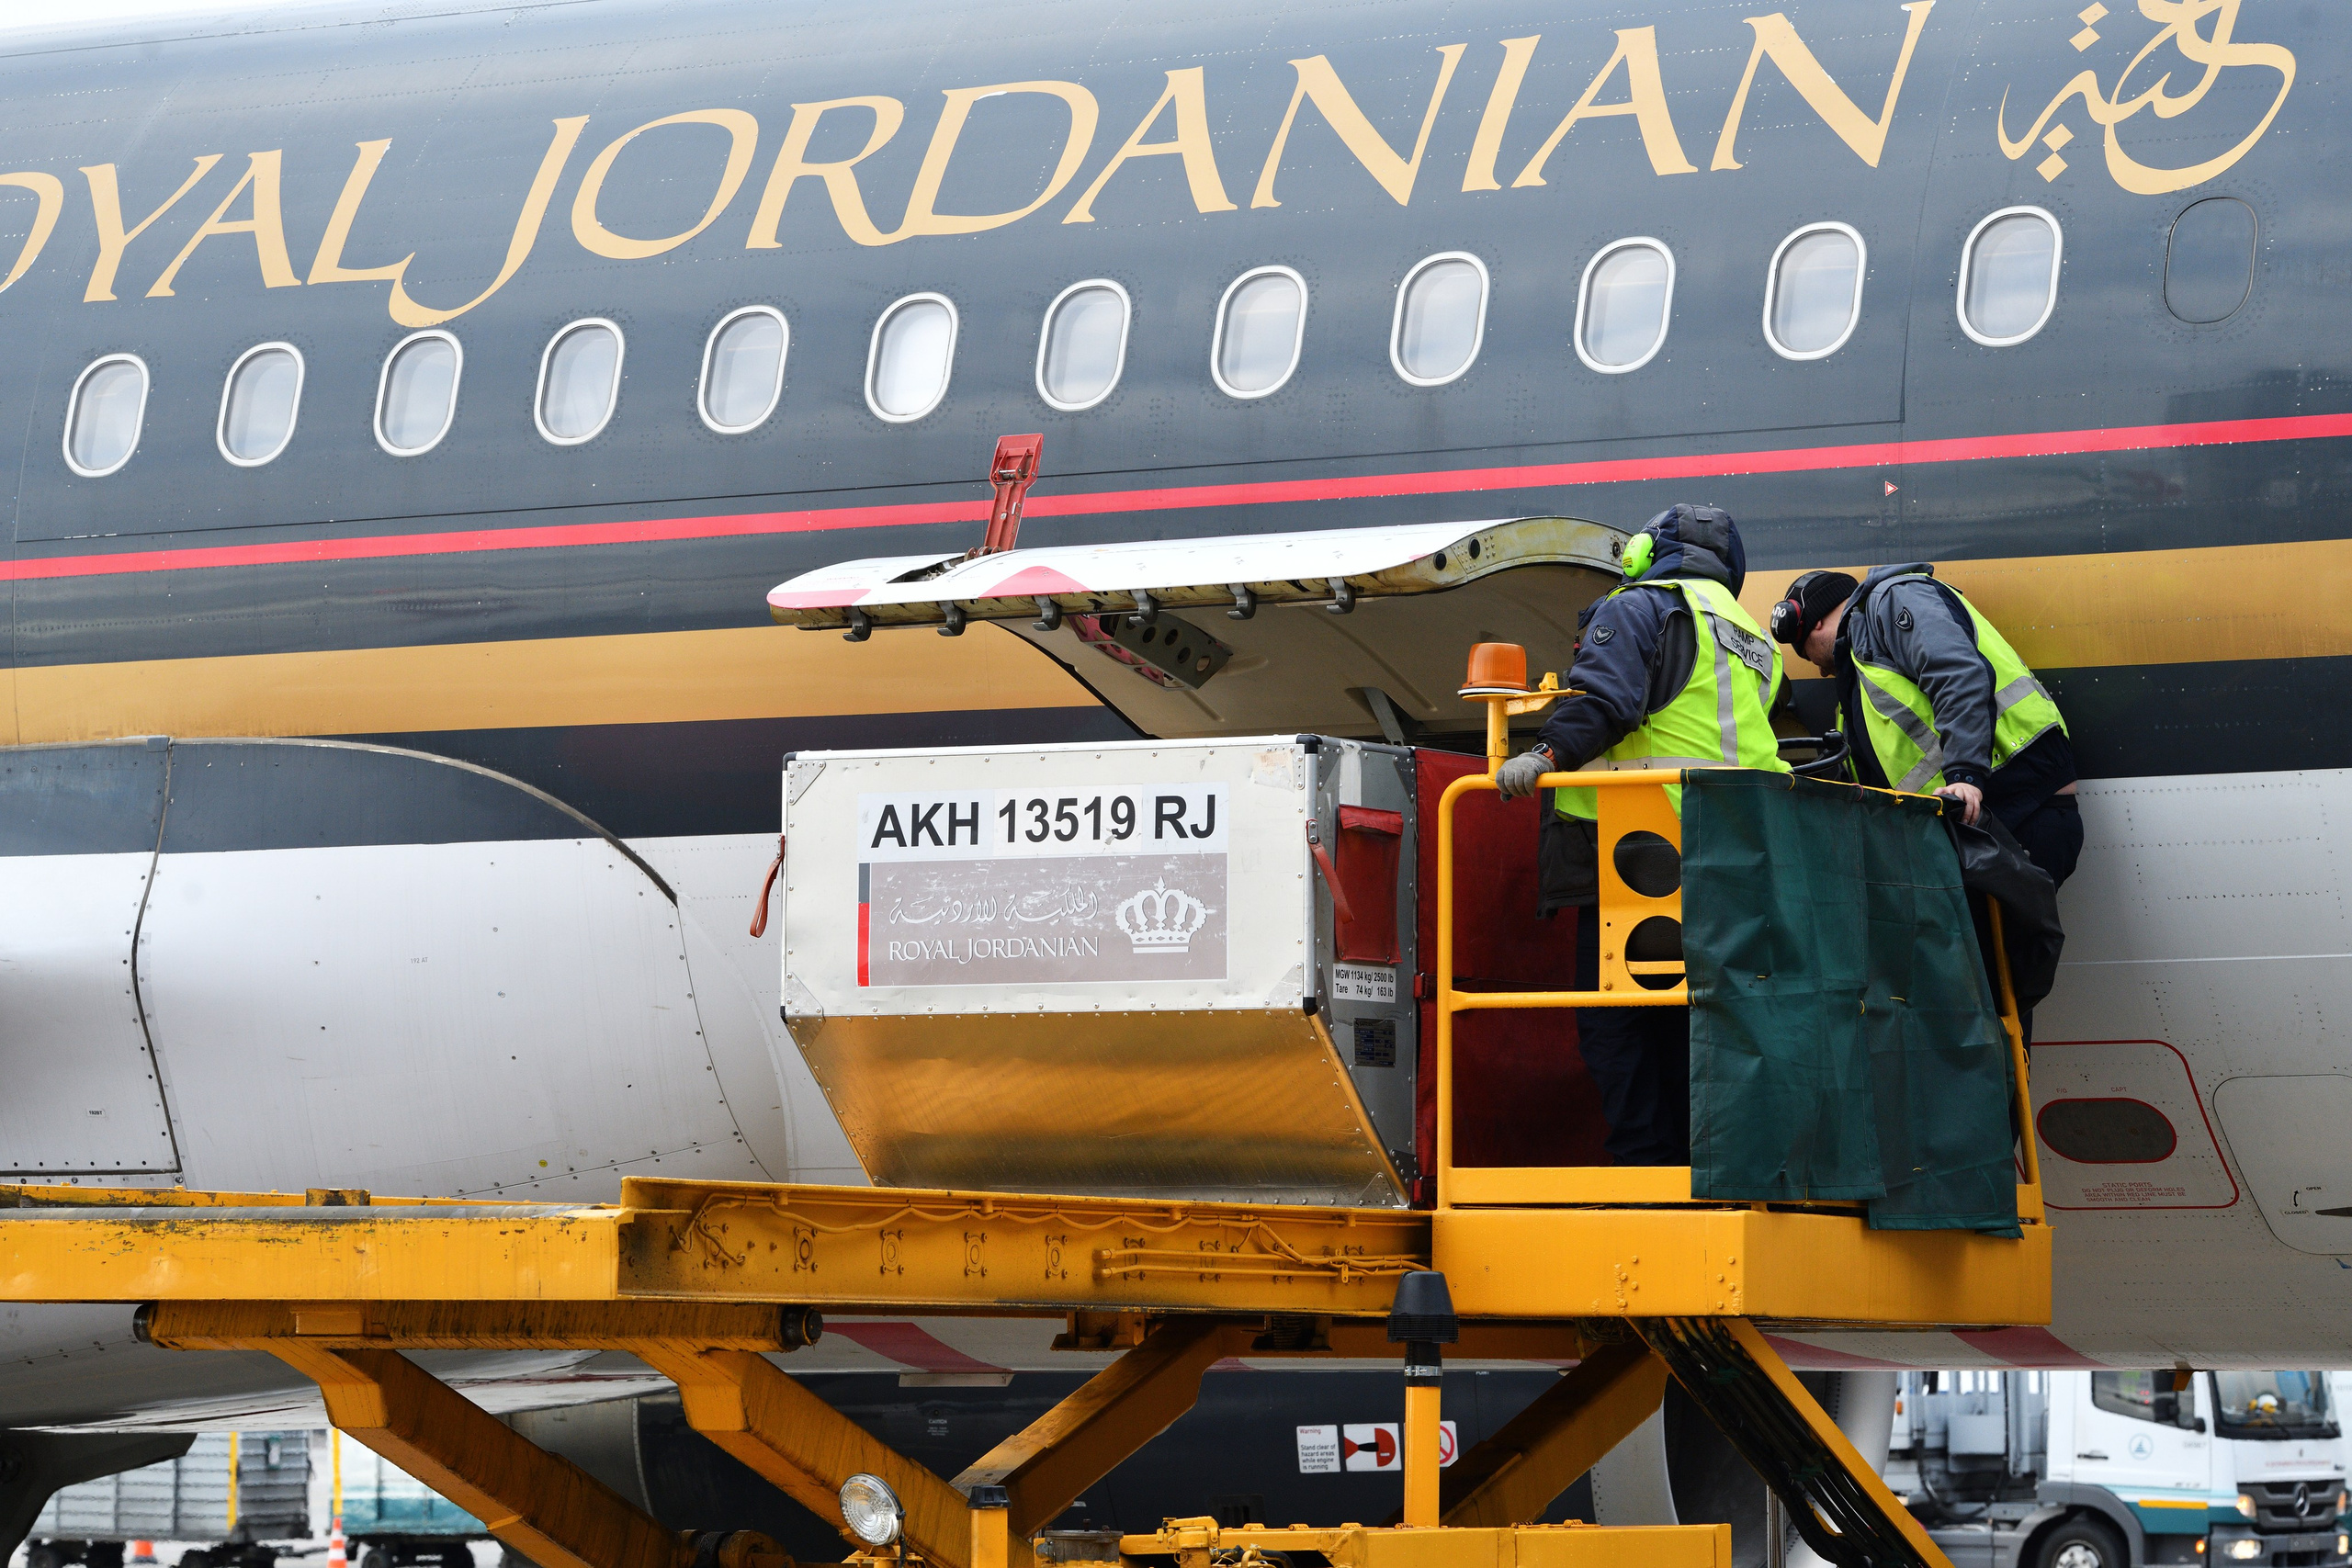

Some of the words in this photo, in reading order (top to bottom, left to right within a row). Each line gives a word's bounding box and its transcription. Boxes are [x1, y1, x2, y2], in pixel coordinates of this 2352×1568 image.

[389, 0, 1936, 328] JORDANIAN
[1732, 625, 1755, 646] RAMP
[870, 801, 979, 849] AKH
[998, 795, 1136, 843] 13519
[1154, 794, 1216, 840] RJ
[888, 939, 960, 961] ROYAL
[957, 936, 1100, 964] JORDANIAN
[1335, 968, 1351, 980] MGW
[1351, 970, 1363, 981] 1134
[1374, 972, 1387, 983] 2500
[1387, 973, 1394, 983] lb
[1335, 983, 1349, 994] Tare
[1356, 985, 1363, 995] 74
[1376, 987, 1387, 997] 163
[1387, 987, 1394, 998] lb
